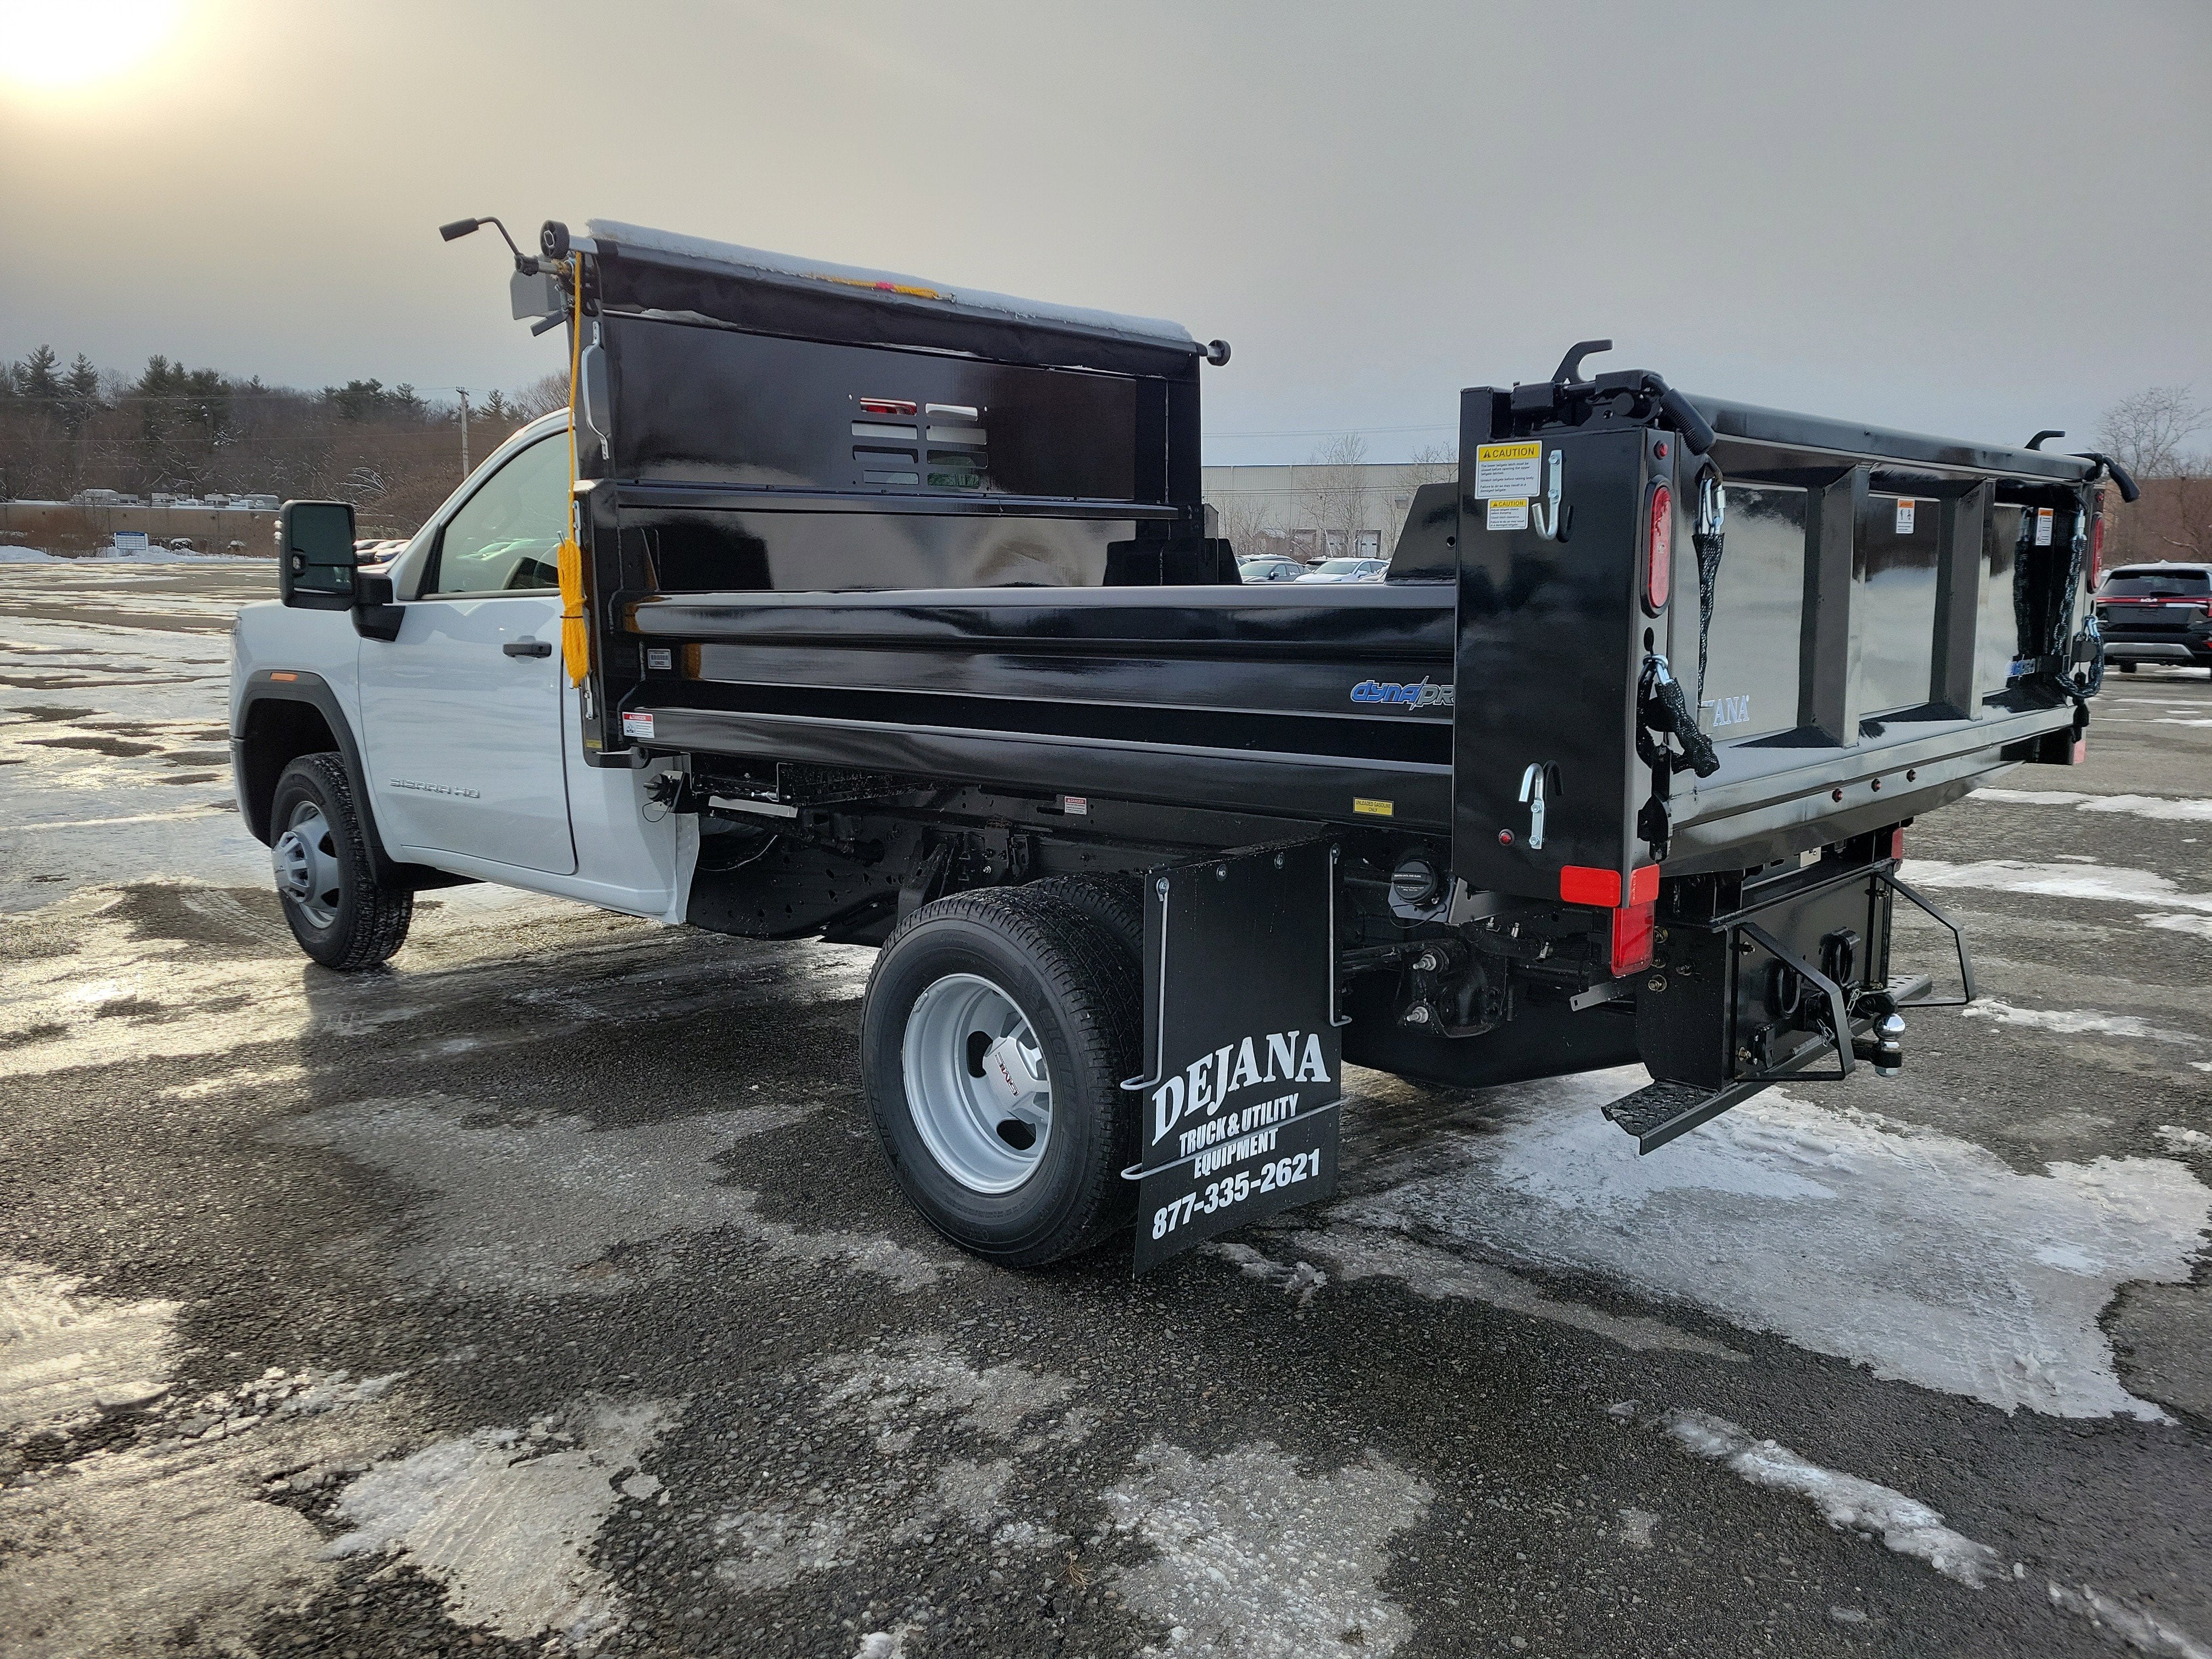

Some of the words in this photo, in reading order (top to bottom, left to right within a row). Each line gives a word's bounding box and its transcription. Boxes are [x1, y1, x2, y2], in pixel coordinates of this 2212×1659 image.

[1493, 448, 1534, 458] CAUTION
[388, 778, 451, 794] SIERRA
[995, 1052, 1019, 1097] GMC
[1152, 1030, 1331, 1146] DEJANA
[1179, 1118, 1226, 1158] TRUCK
[1227, 1112, 1240, 1137] &
[1242, 1093, 1299, 1132] UTILITY
[1194, 1127, 1278, 1180] EQUIPMENT
[1152, 1148, 1320, 1240] 877-335-2621
